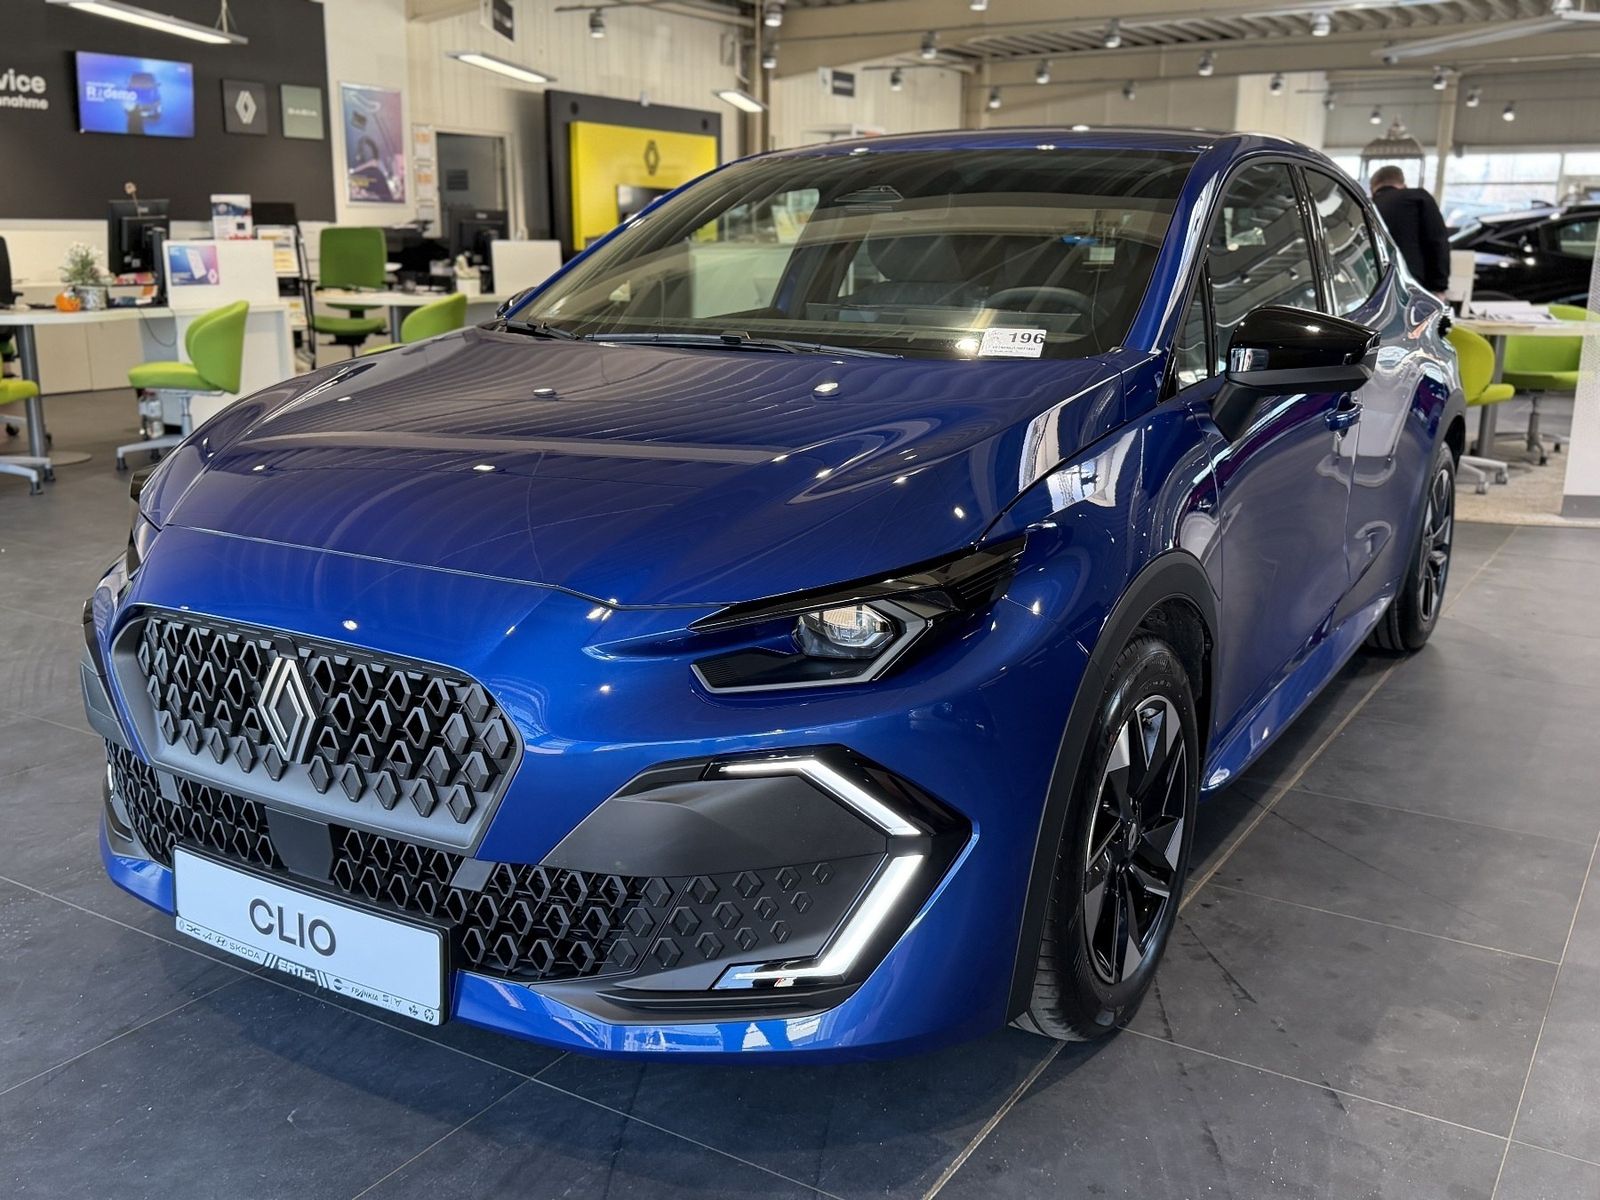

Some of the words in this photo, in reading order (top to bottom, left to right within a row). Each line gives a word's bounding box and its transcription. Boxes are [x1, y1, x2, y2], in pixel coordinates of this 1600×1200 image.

[0, 95, 49, 110] nahme
[1008, 332, 1045, 344] 196
[249, 898, 336, 957] CLIO
